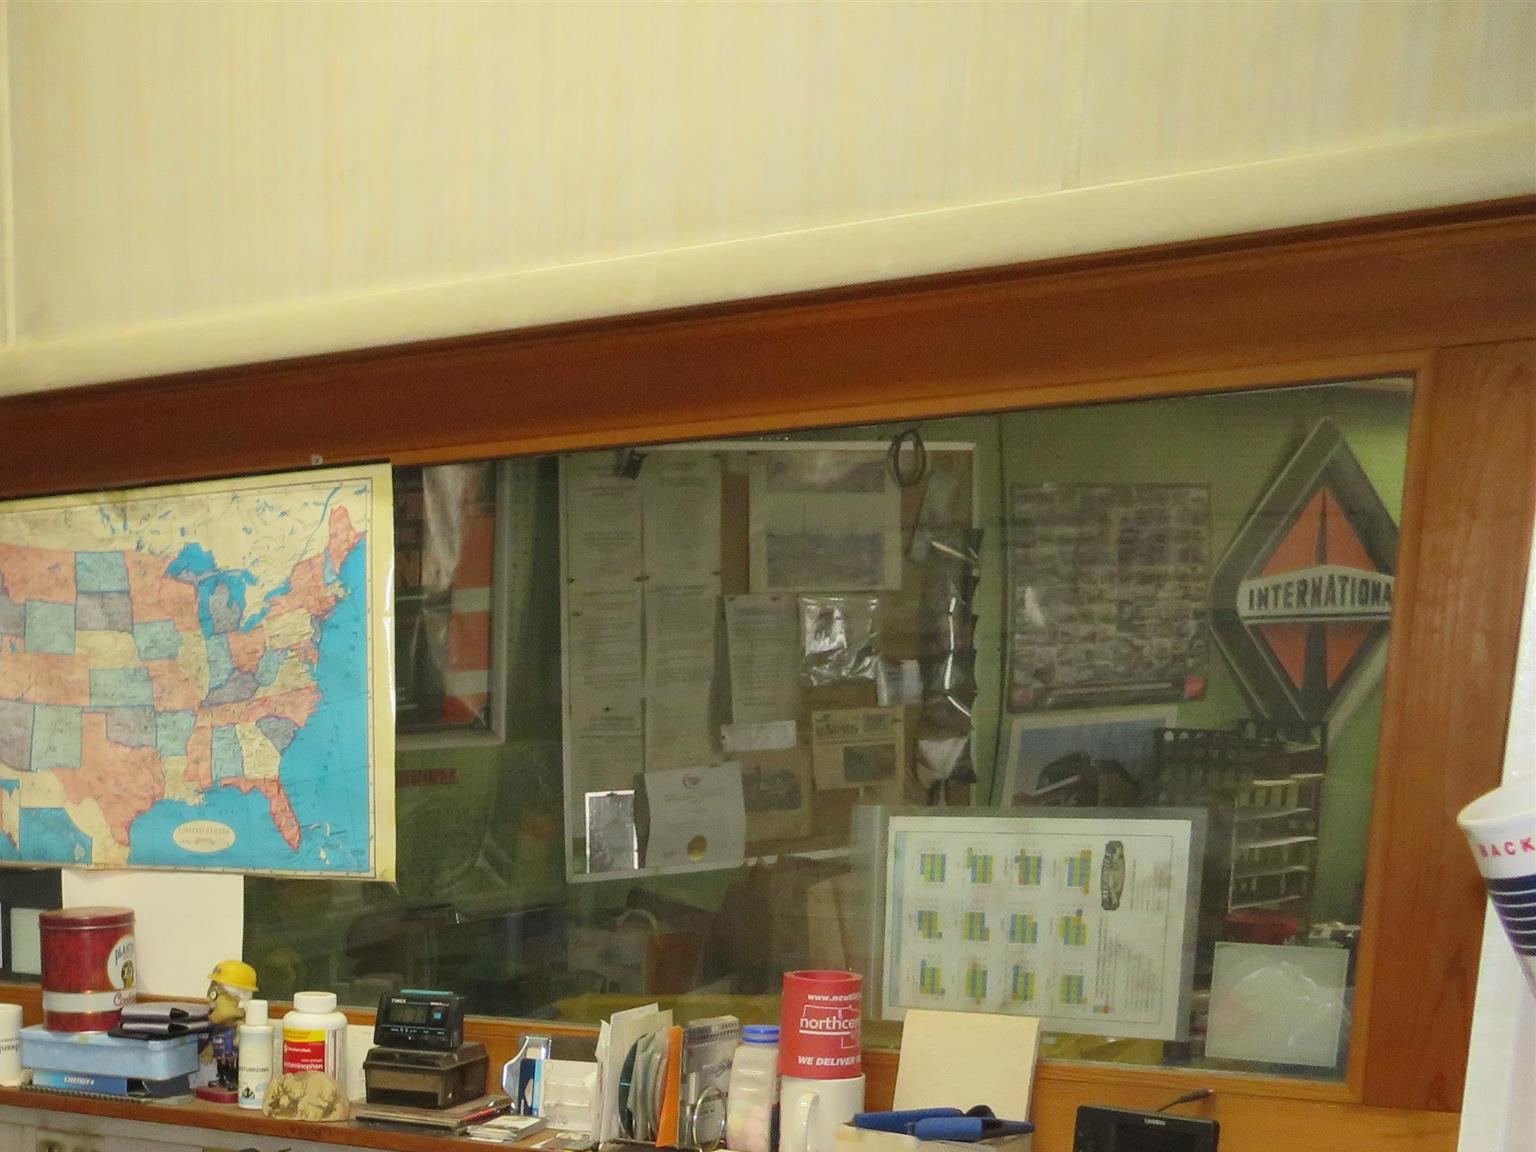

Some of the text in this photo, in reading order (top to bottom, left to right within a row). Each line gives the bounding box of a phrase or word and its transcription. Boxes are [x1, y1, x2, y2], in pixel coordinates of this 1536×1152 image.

[1248, 574, 1392, 610] INTERNATIONA
[800, 1015, 860, 1030] northce
[798, 1056, 855, 1066] WE DELIVER
